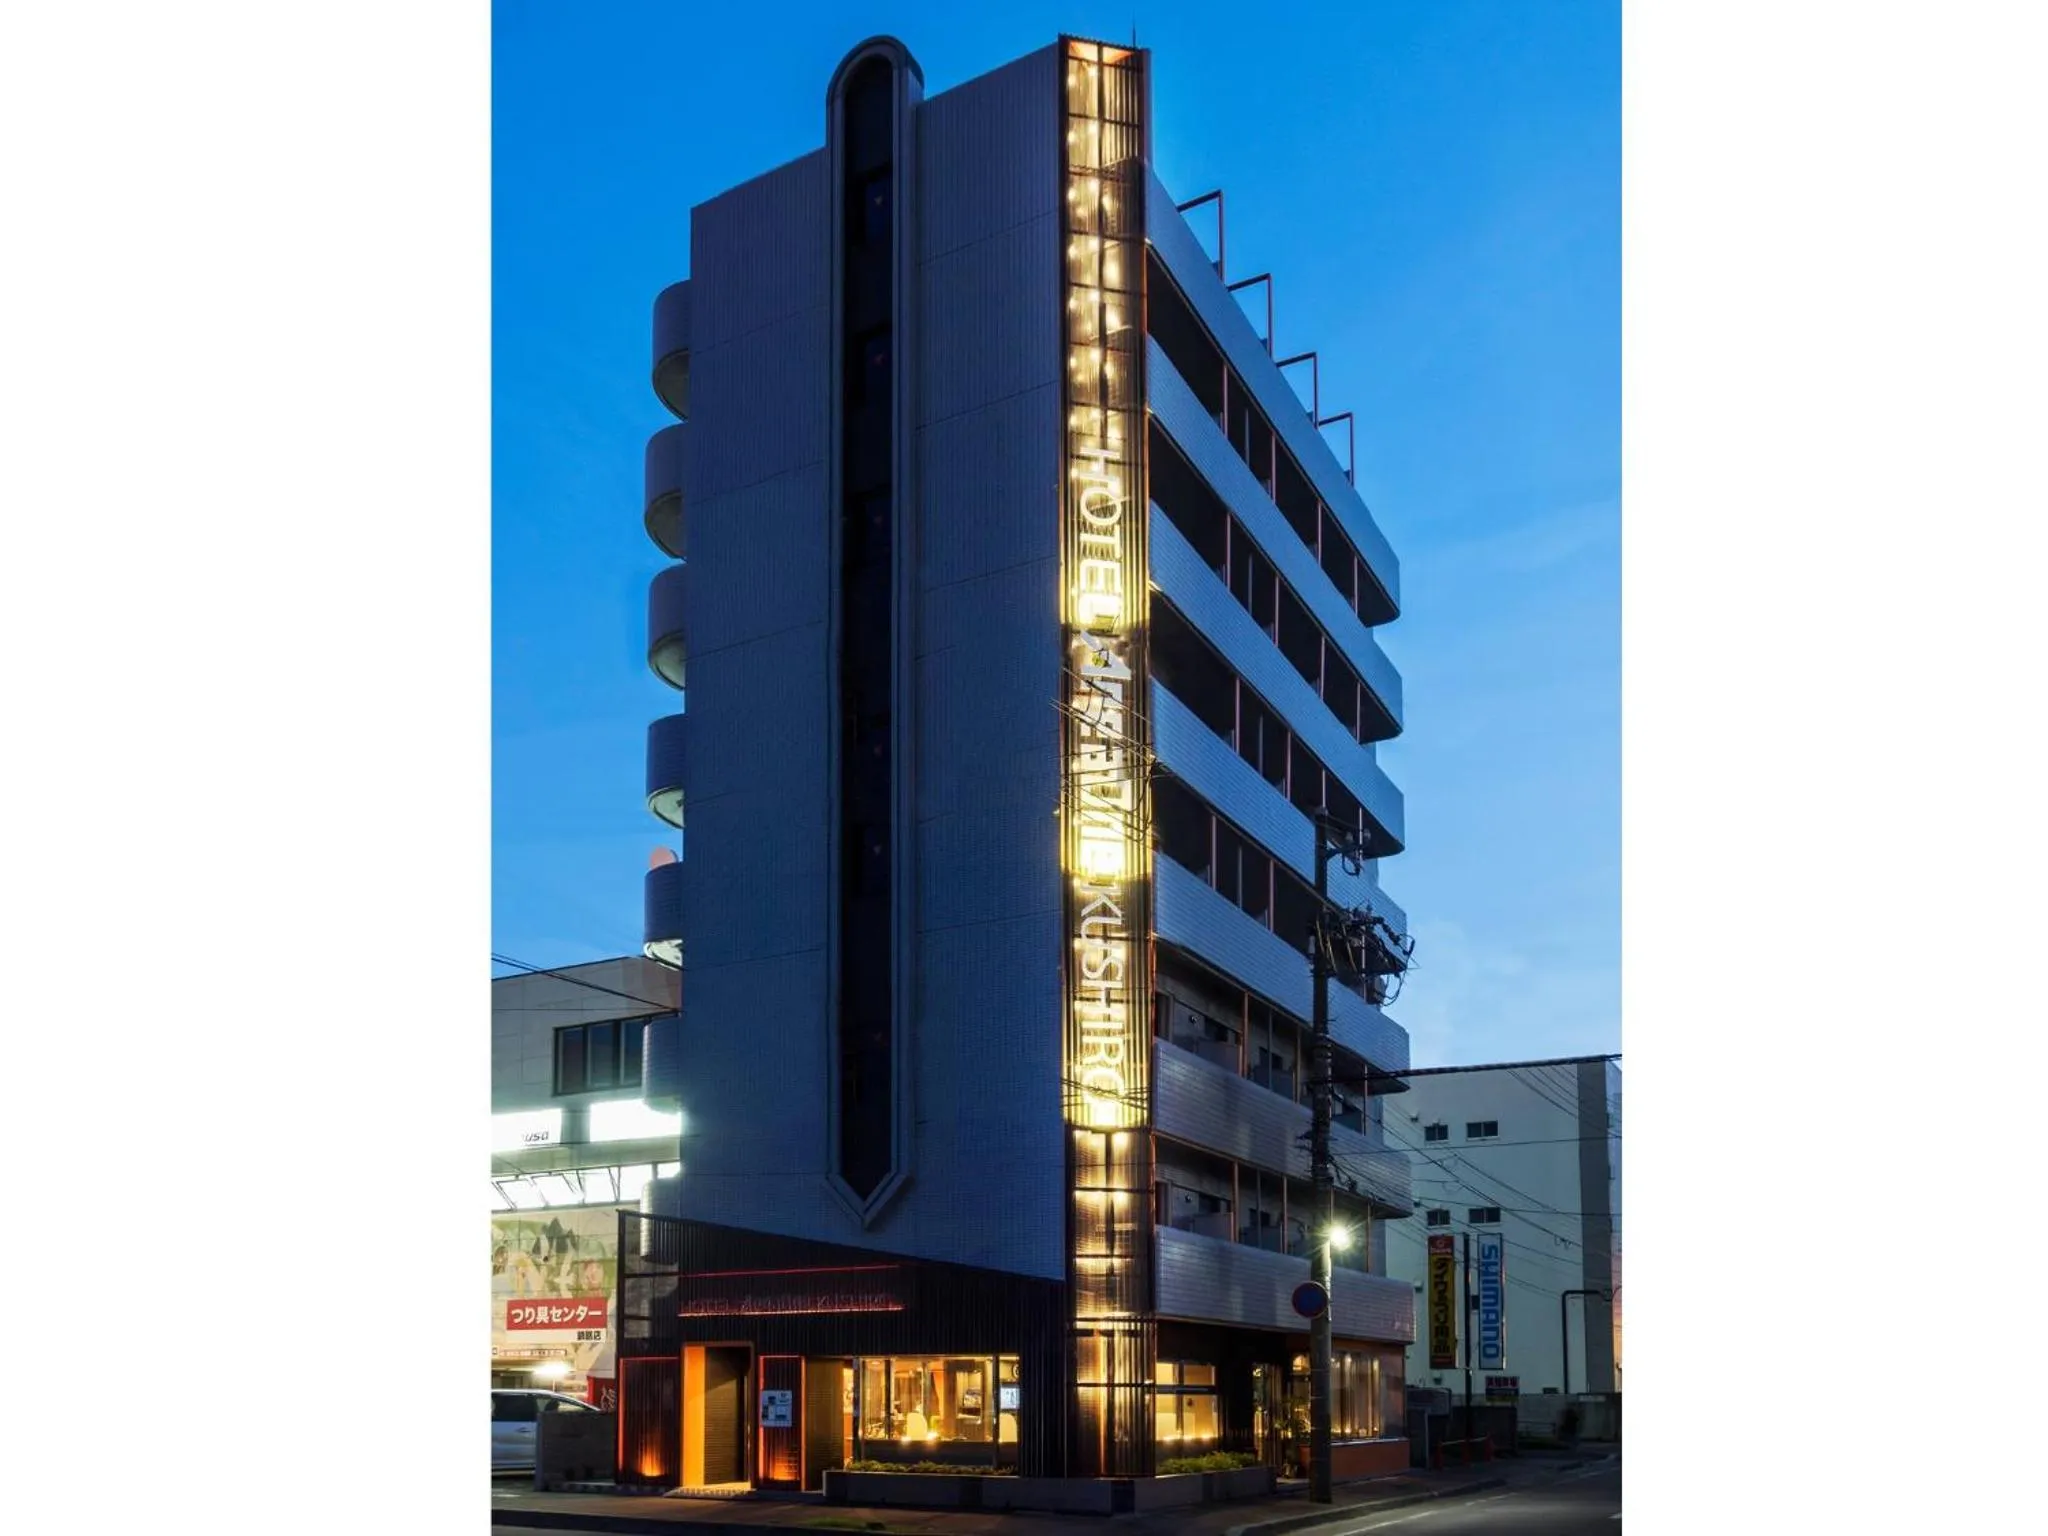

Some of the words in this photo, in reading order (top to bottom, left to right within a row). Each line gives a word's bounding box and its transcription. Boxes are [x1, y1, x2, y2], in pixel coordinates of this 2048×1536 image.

[1079, 448, 1124, 626] HOTEL
[1081, 884, 1126, 1104] KUSHIRO
[511, 1304, 602, 1324] つり具センター
[1481, 1243, 1500, 1359] SHIMANO
